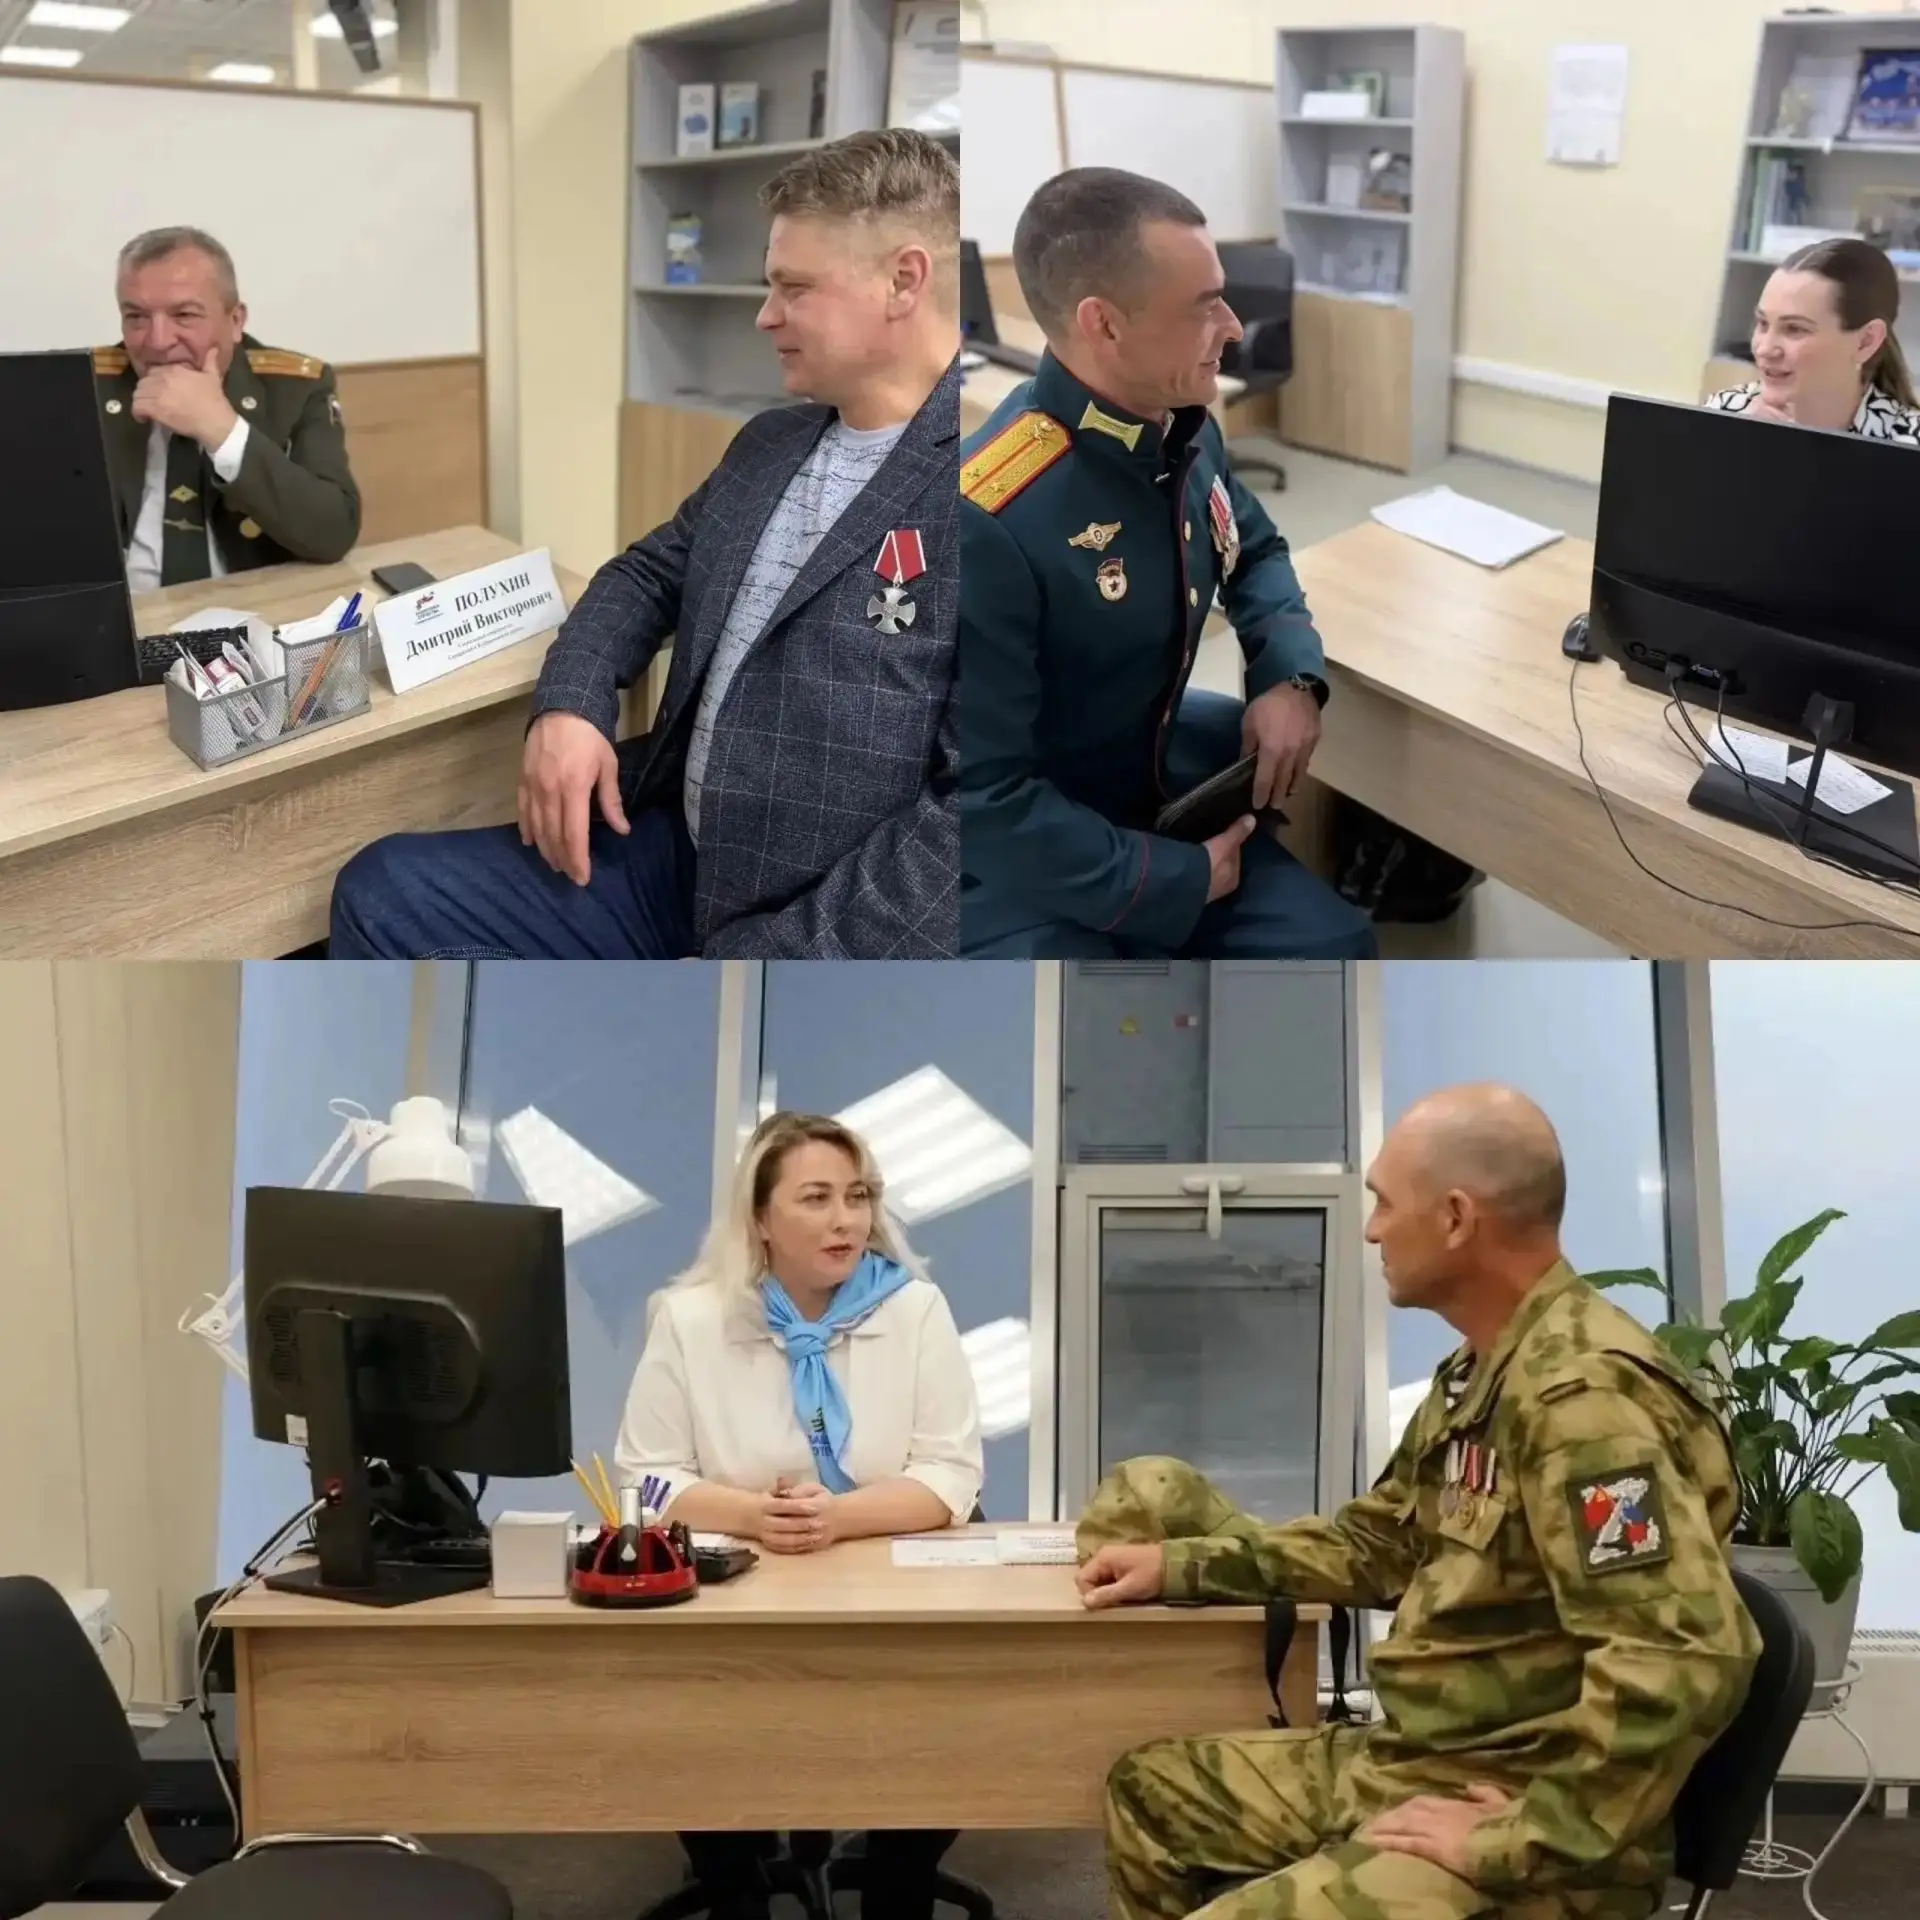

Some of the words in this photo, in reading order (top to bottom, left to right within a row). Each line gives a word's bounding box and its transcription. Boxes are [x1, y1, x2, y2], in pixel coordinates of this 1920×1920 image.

[455, 572, 531, 612] ПОЛУХИН
[406, 619, 473, 660] Дмитрий
[474, 591, 553, 630] Викторович
